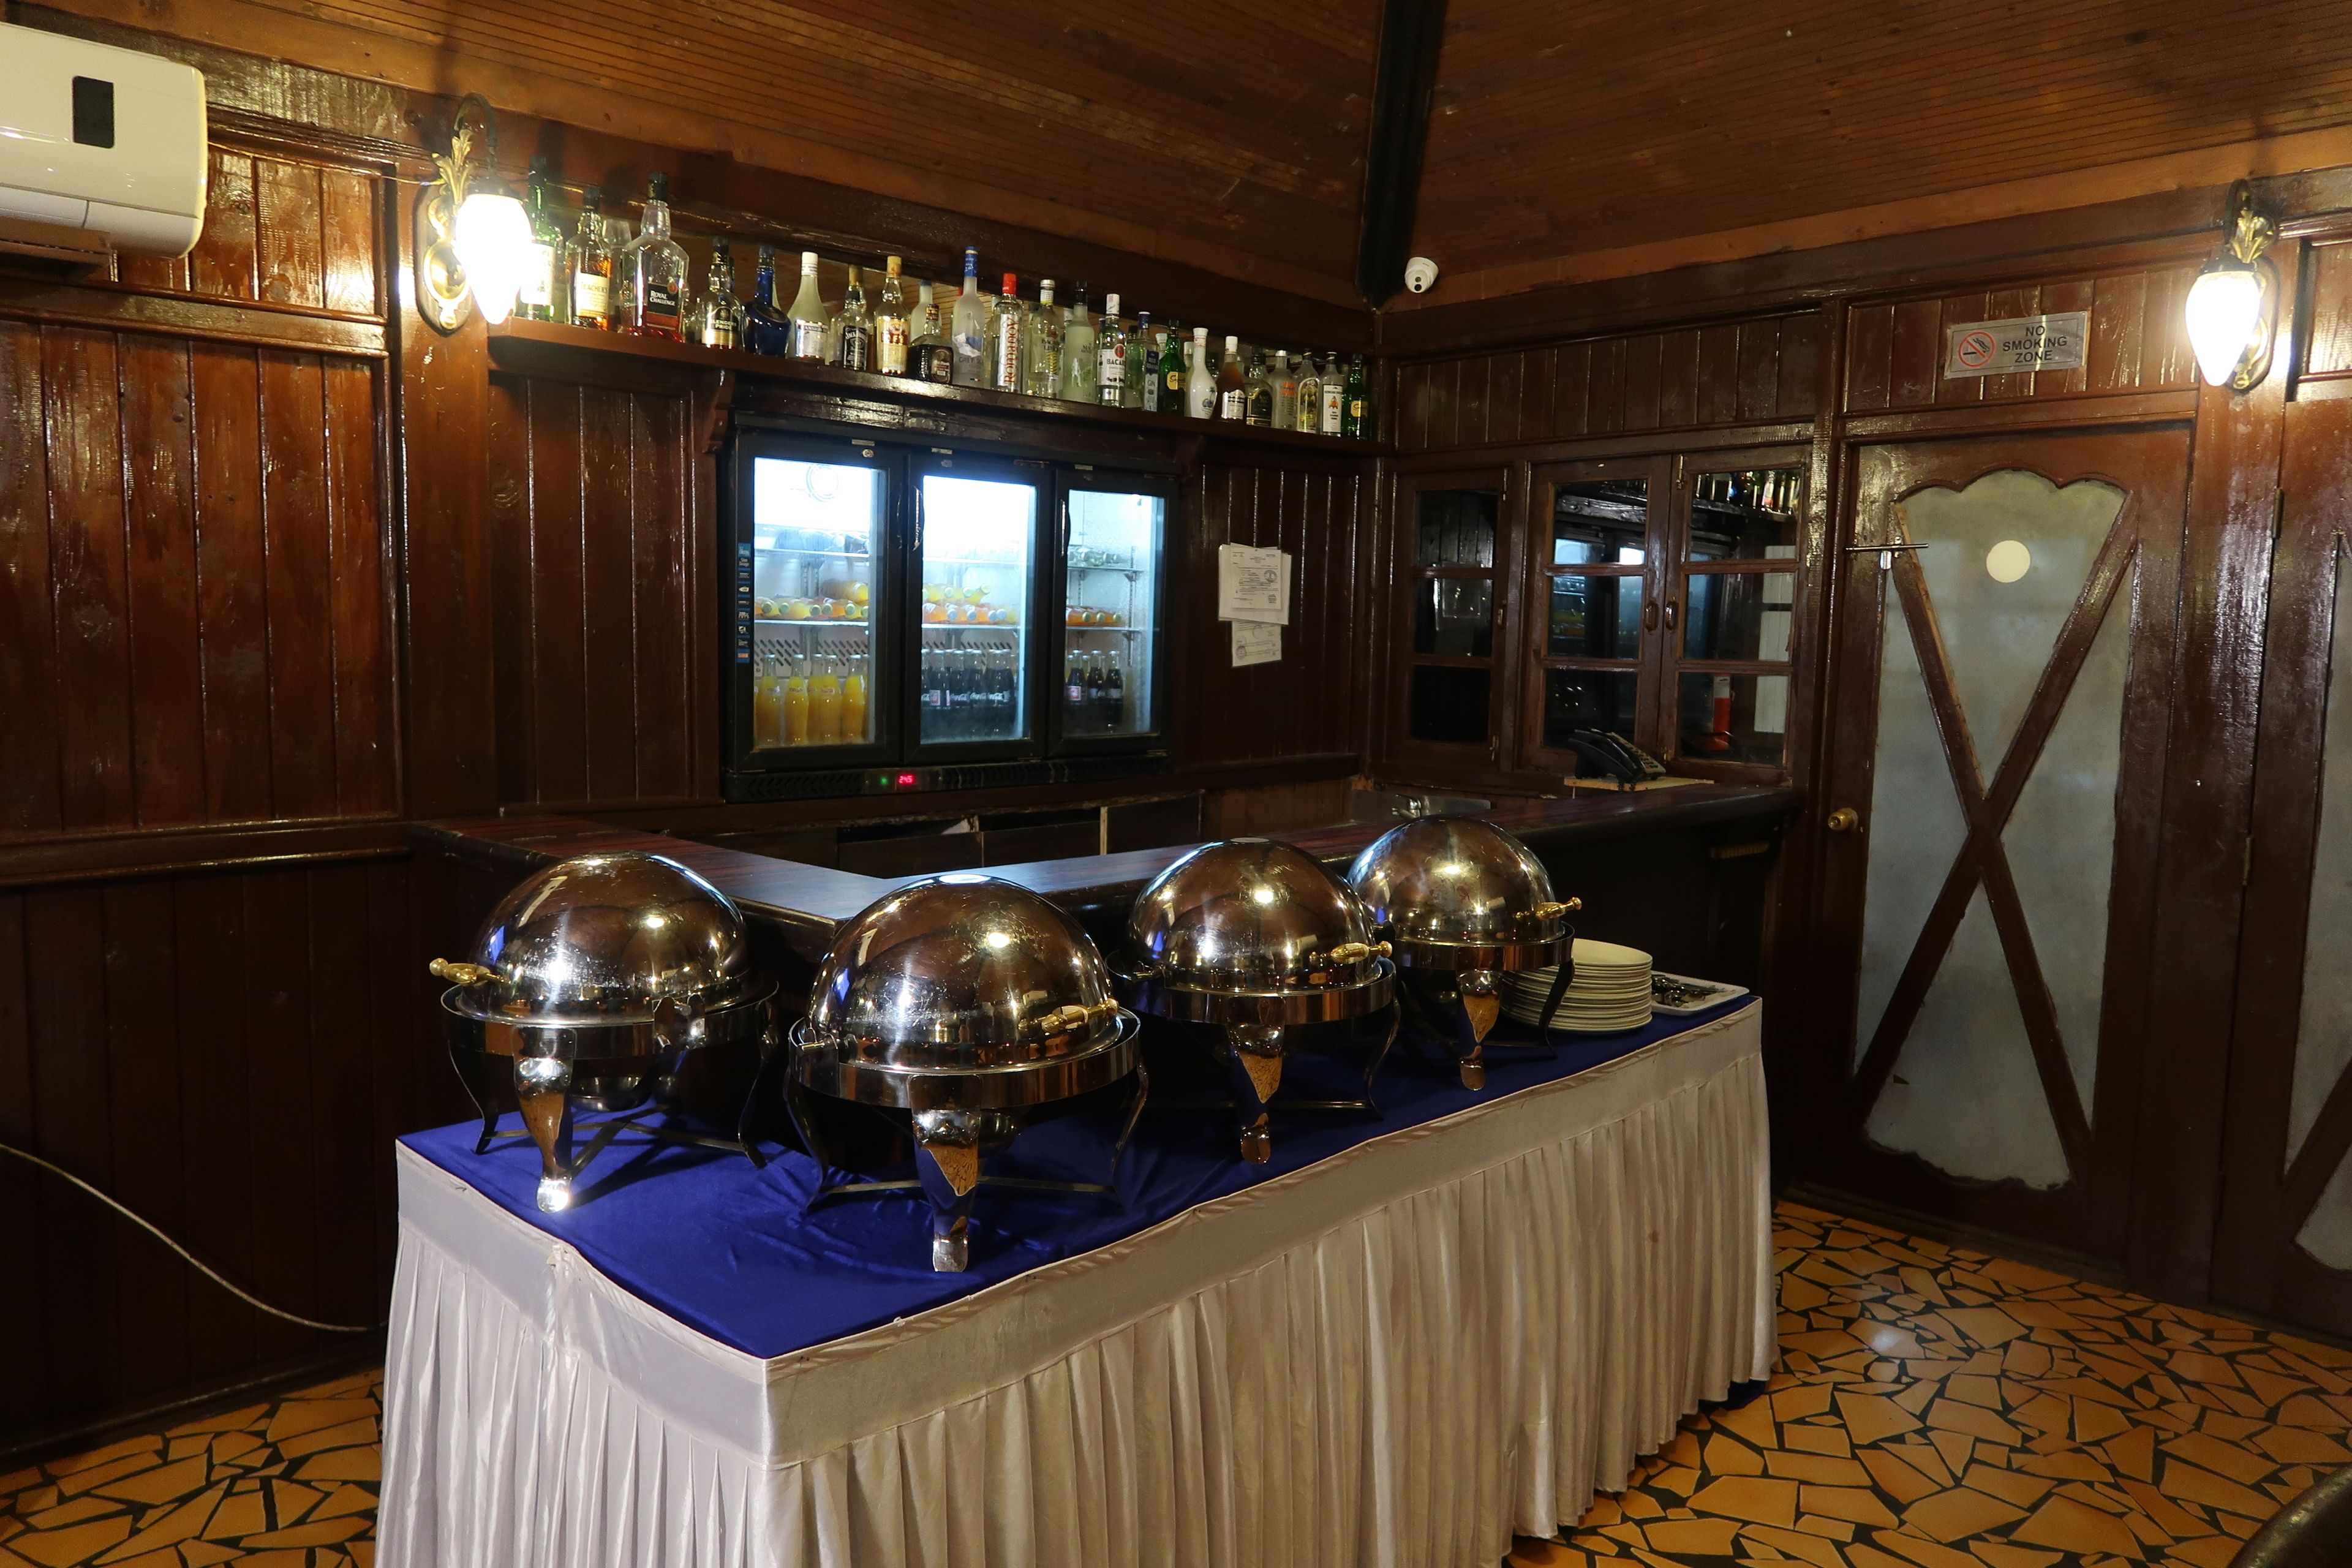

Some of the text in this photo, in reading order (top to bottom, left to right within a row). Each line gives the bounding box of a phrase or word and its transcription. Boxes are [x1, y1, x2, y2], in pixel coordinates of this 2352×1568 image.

[650, 290, 668, 300] ROYAL
[649, 297, 676, 306] CHALLENGE
[2026, 325, 2045, 336] NO
[2002, 336, 2068, 352] SMOKING
[2015, 350, 2053, 363] ZONE
